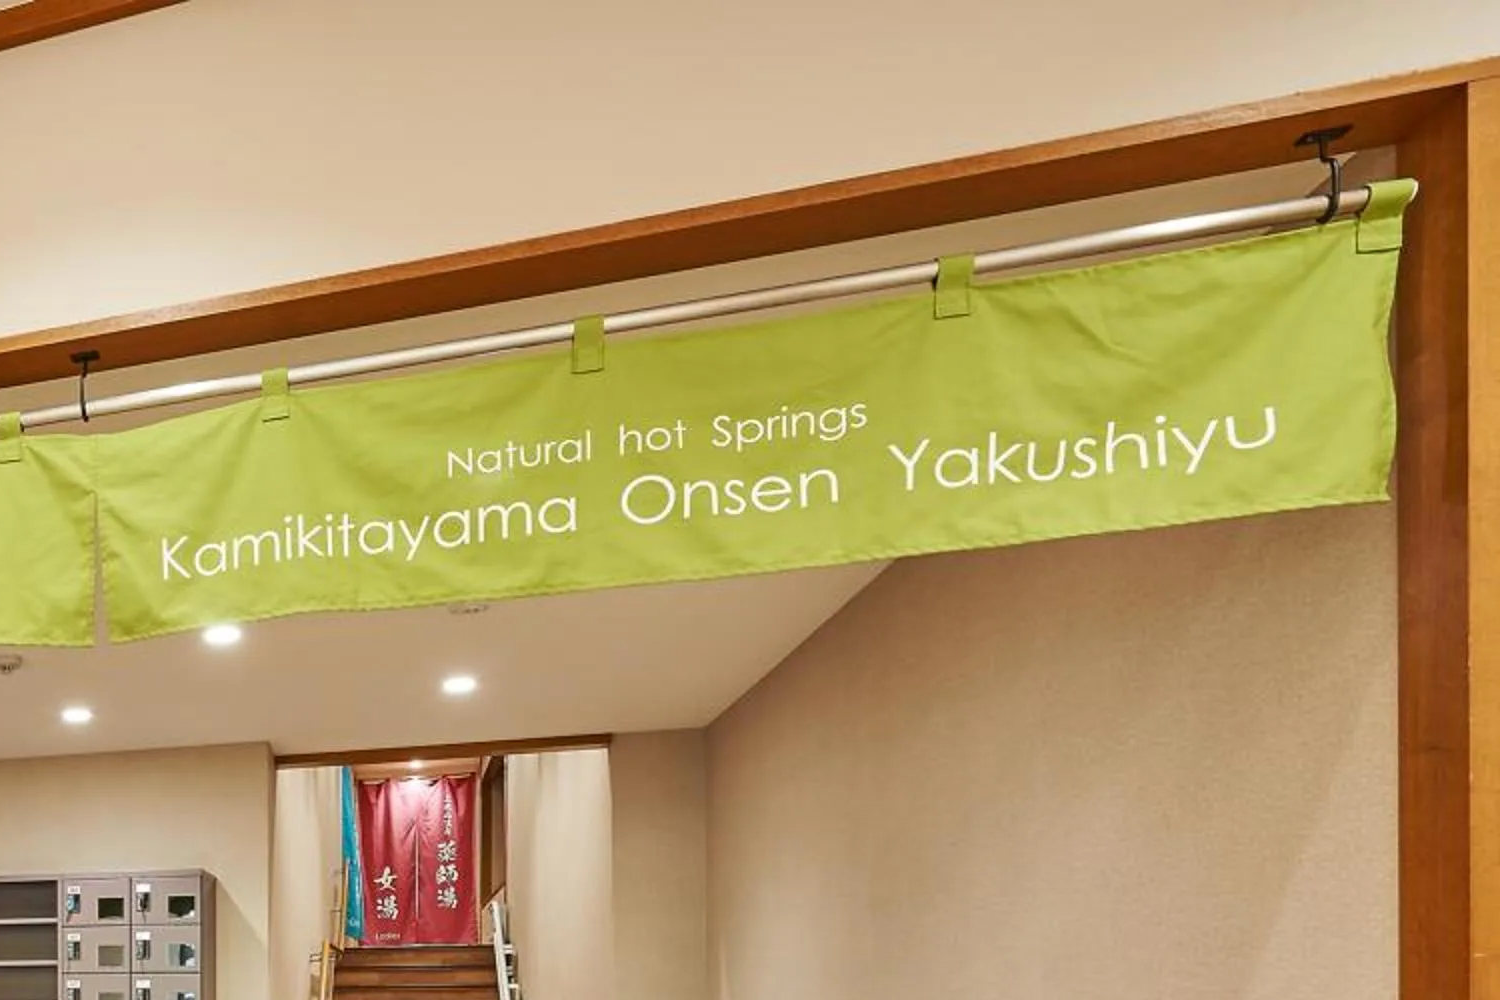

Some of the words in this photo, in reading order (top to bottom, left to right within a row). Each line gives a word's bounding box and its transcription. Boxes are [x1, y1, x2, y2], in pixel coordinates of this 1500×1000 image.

[447, 431, 593, 477] Natural
[619, 424, 687, 457] hot
[711, 402, 868, 450] Springs
[161, 496, 578, 580] Kamikitayama
[620, 467, 840, 526] Onsen
[887, 406, 1277, 491] Yakushiyu
[373, 866, 399, 920] 女湯
